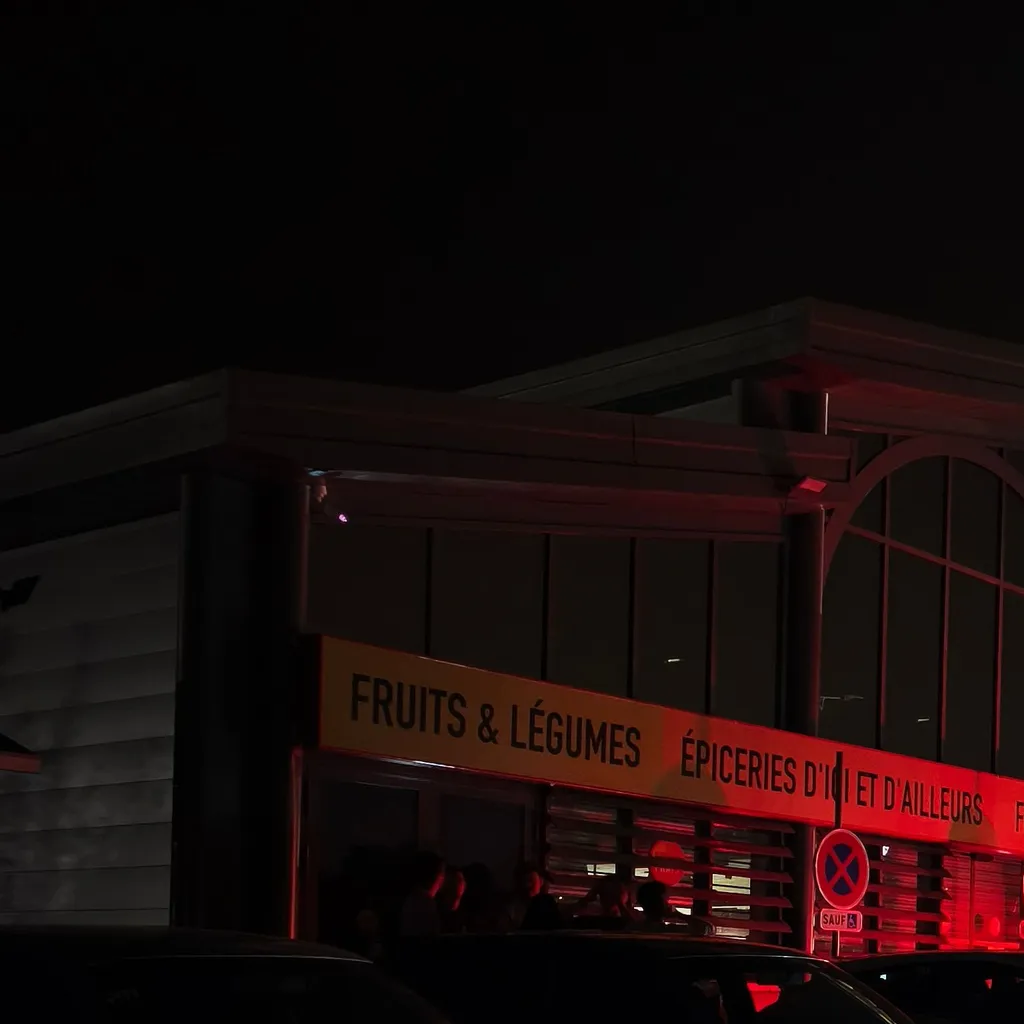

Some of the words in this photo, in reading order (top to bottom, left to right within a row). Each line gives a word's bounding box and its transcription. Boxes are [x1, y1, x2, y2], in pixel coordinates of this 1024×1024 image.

[351, 673, 467, 738] FRUITS
[477, 703, 499, 745] &
[510, 700, 641, 768] LÉGUMES
[680, 729, 797, 795] ÉPICERIES
[857, 771, 879, 809] ET
[884, 776, 984, 827] D'AILLEURS
[823, 913, 846, 926] SAUF
